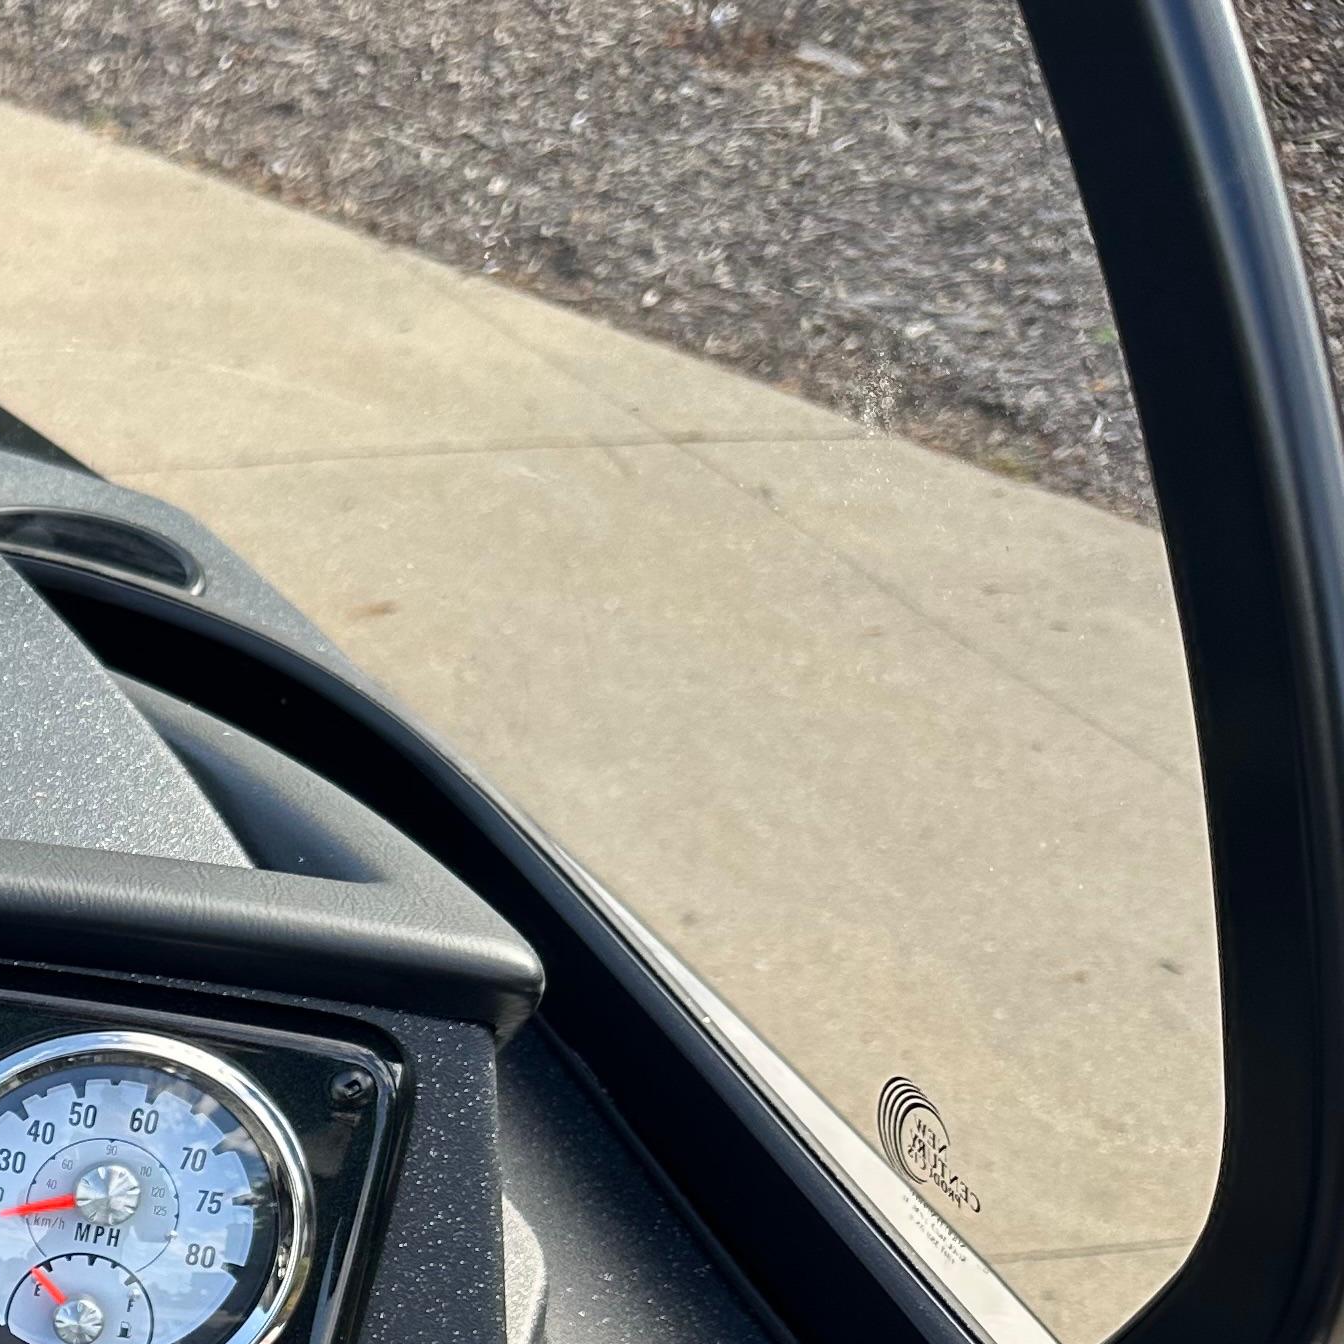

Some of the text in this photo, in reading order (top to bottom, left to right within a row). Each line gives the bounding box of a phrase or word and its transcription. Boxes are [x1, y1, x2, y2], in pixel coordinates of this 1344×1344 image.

[69, 1102, 97, 1129] 50
[130, 1108, 159, 1135] 60
[27, 1121, 56, 1146] 40
[106, 1144, 118, 1156] 90
[180, 1148, 207, 1172] 70
[195, 1190, 222, 1214] 75
[33, 1216, 65, 1230] km/h
[74, 1223, 121, 1247] MPH
[186, 1244, 216, 1268] 80
[34, 1283, 41, 1298] E
[126, 1297, 136, 1314] F
